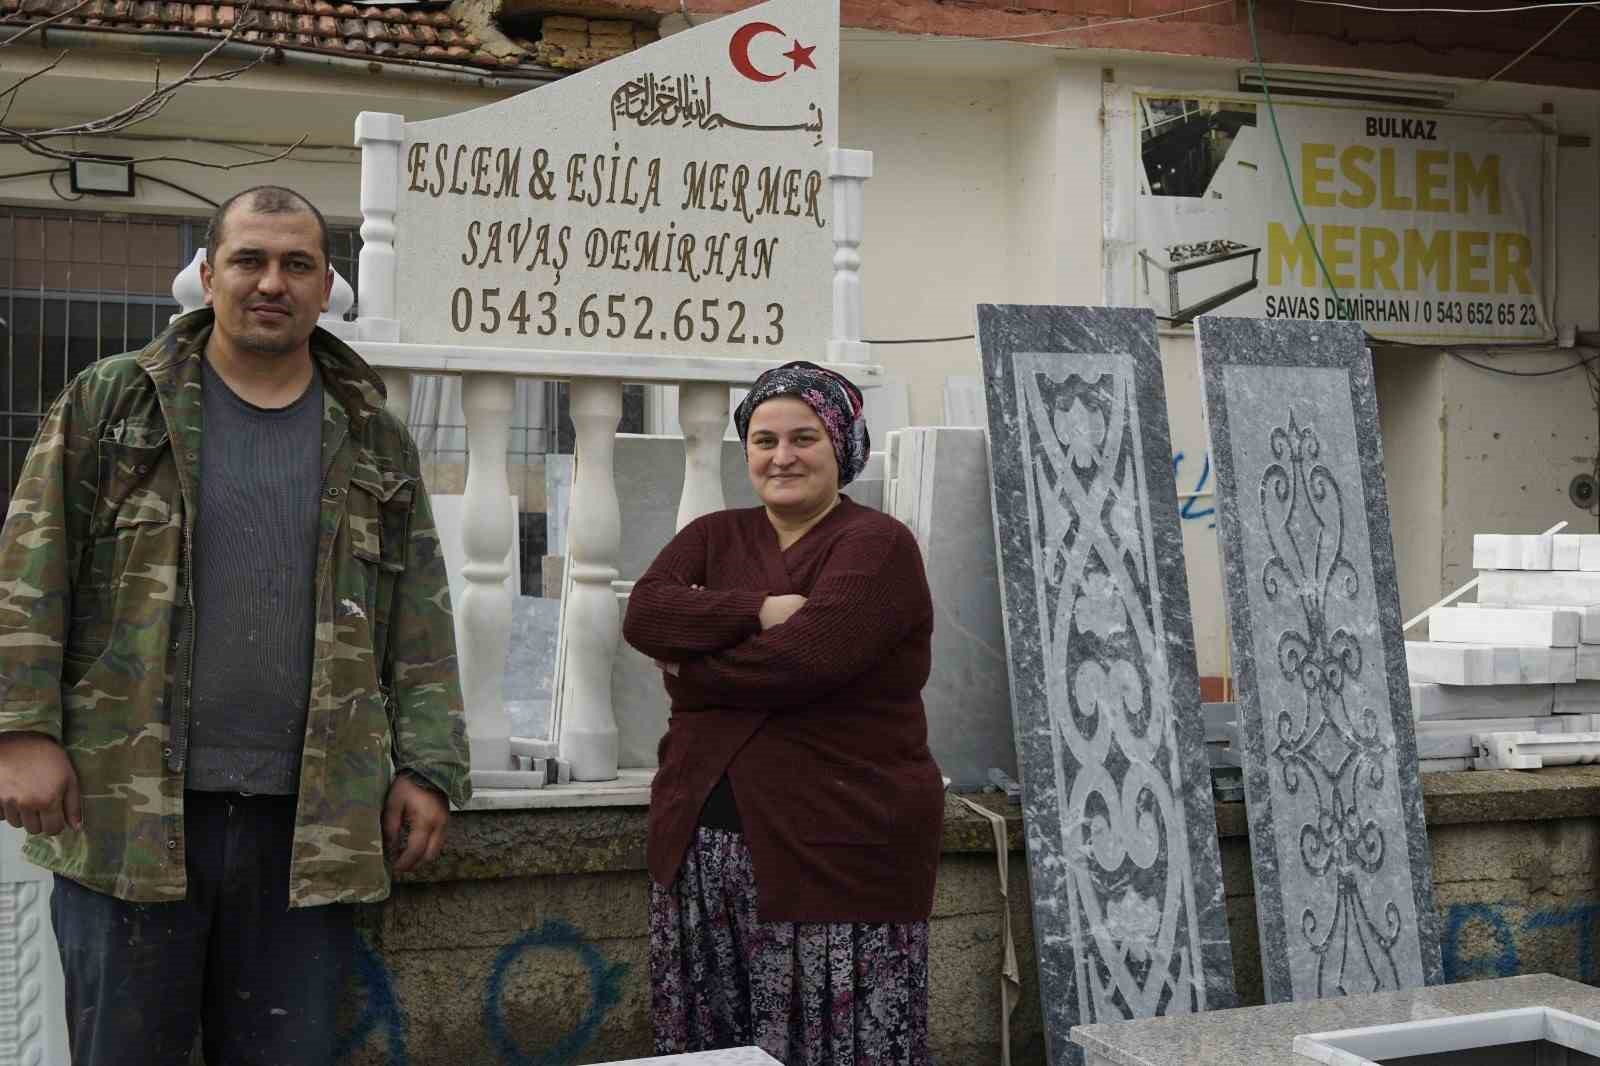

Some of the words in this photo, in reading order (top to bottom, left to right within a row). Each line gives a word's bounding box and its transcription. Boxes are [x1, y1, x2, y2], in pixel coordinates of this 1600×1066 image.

[1366, 116, 1437, 141] BULKAZ
[407, 142, 522, 199] ESLEM
[528, 148, 557, 201] &
[566, 141, 662, 214] ESİLA
[680, 159, 826, 229] MERMER
[1301, 143, 1504, 216] ESLEM
[461, 216, 572, 287] SAVAŞ
[585, 221, 779, 283] DEMİRHAN
[1266, 221, 1536, 294] MERMER
[450, 287, 785, 346] 0543.652.652.3
[1324, 293, 1410, 322] DEMİRHAN
[1423, 301, 1433, 322] 0
[1436, 301, 1463, 324] 543
[1466, 302, 1494, 325] 652
[1497, 303, 1516, 325] 65
[1519, 303, 1537, 326] 23
